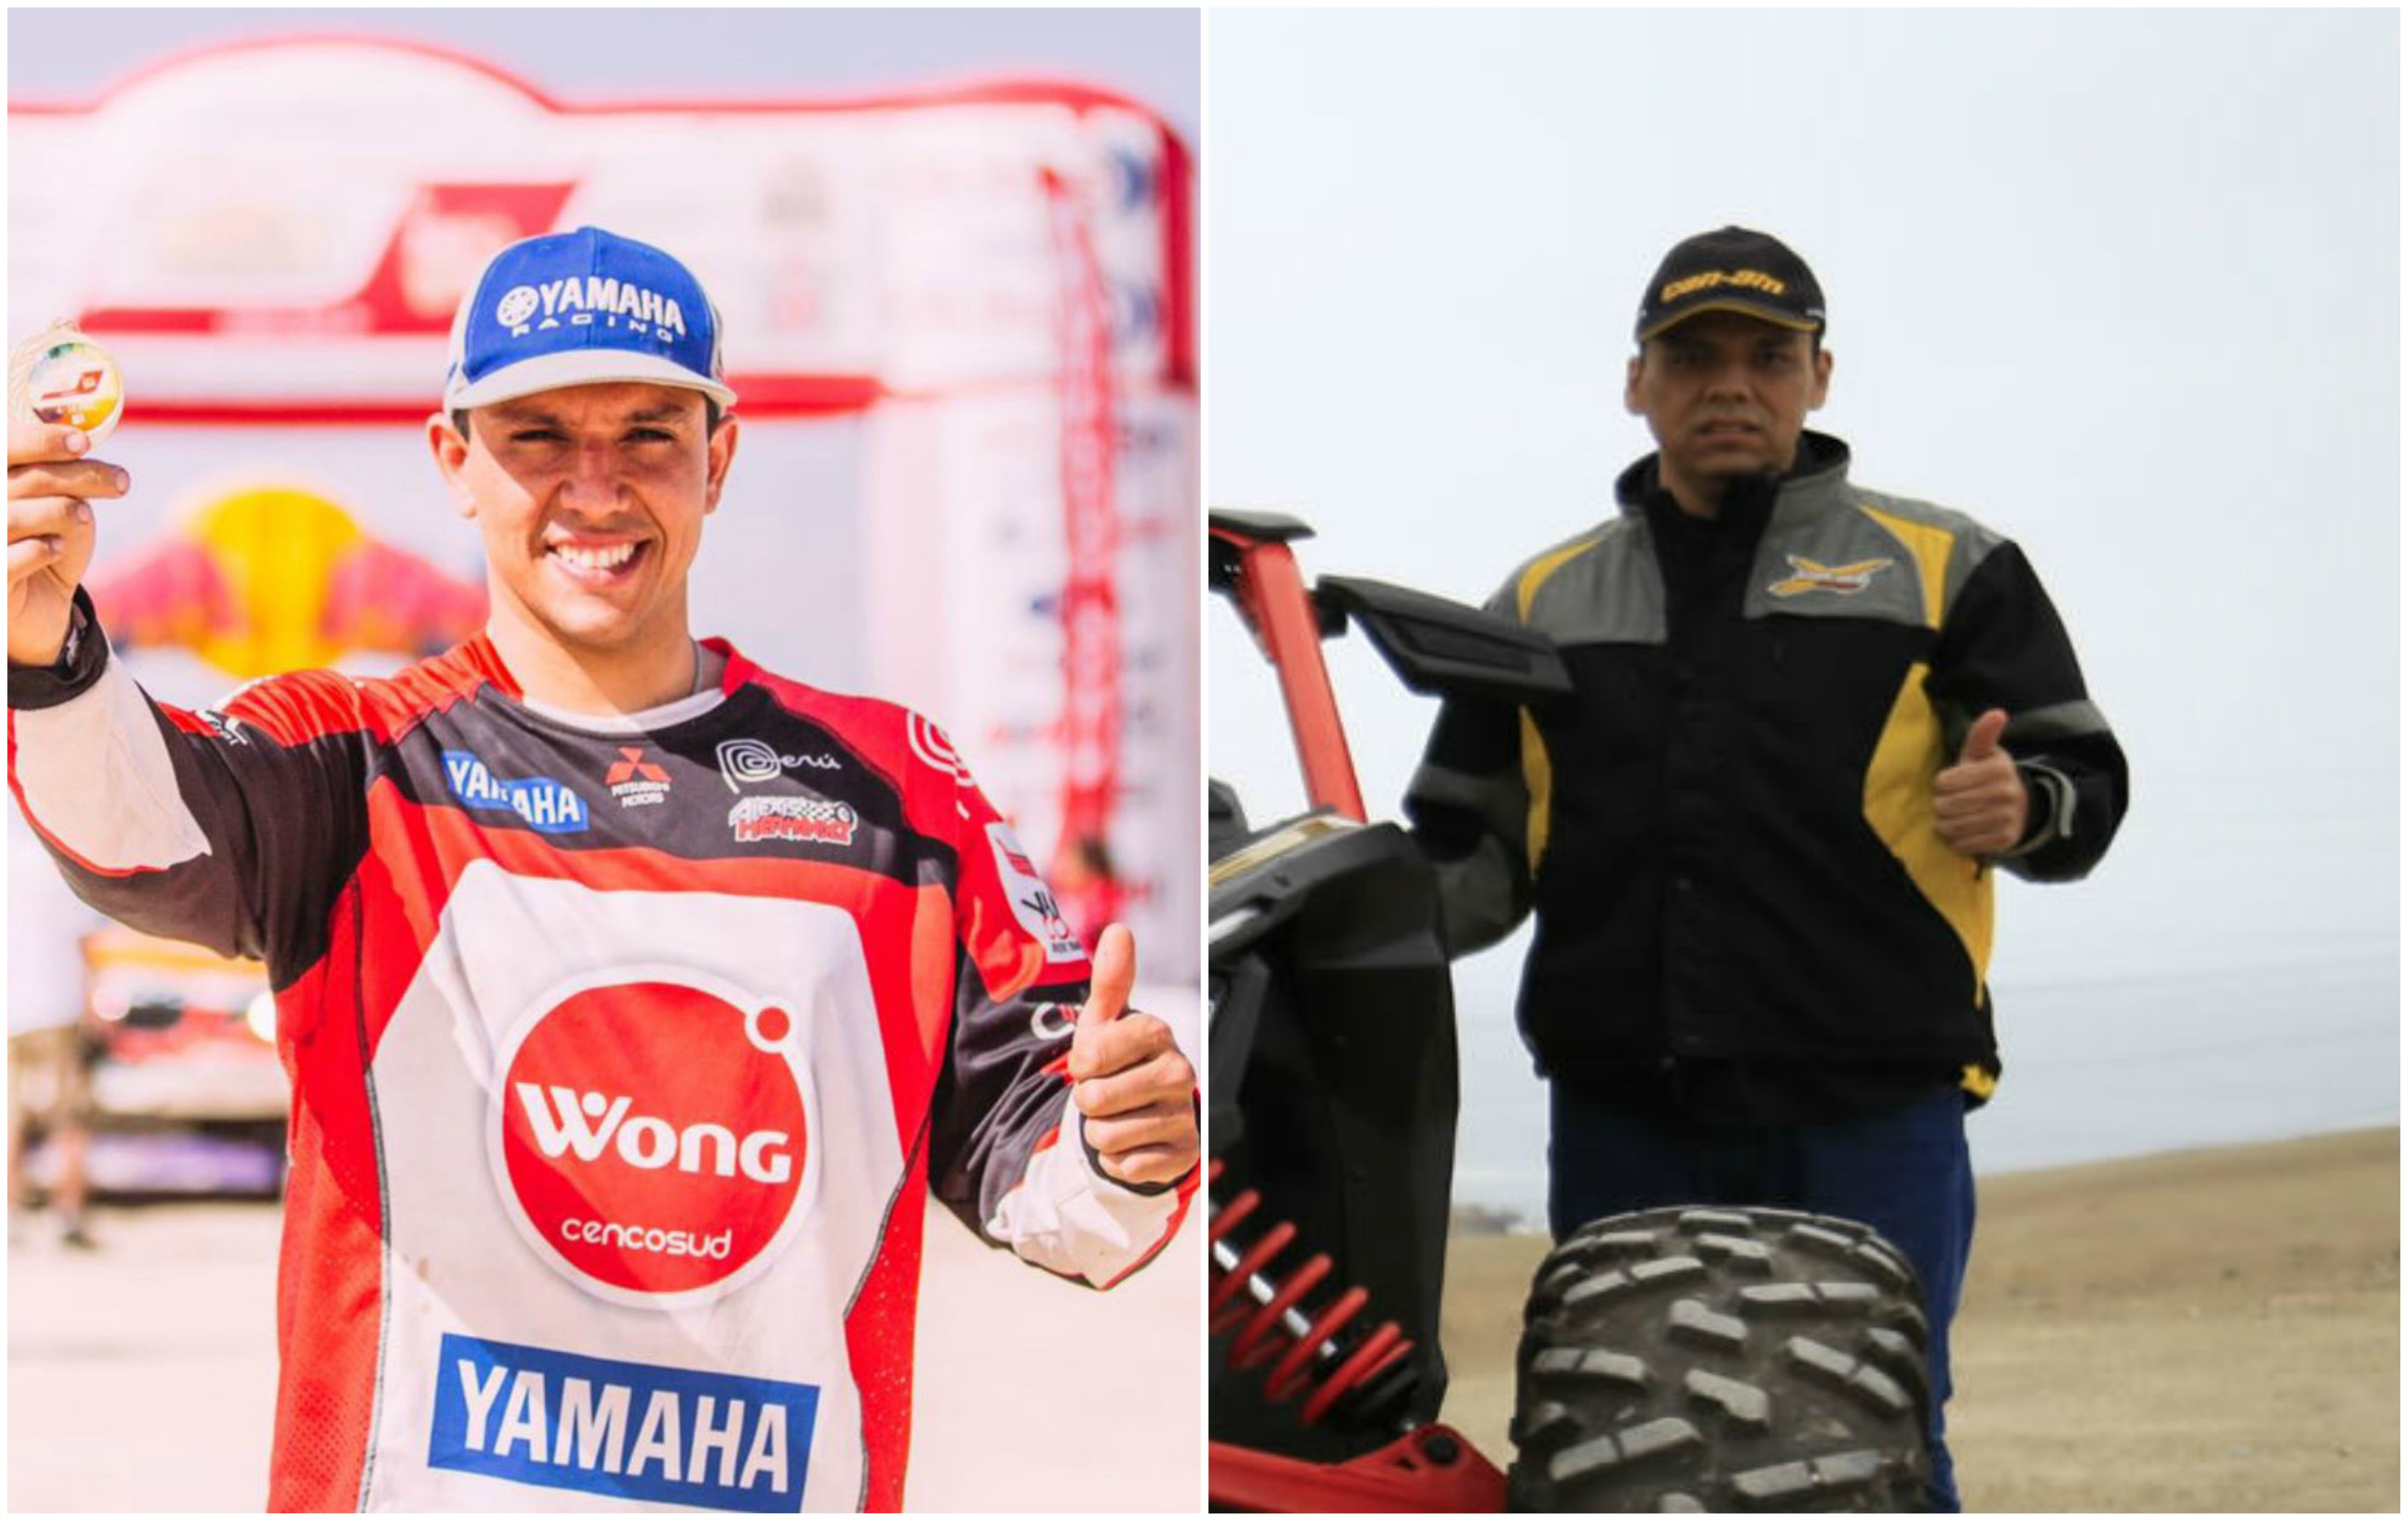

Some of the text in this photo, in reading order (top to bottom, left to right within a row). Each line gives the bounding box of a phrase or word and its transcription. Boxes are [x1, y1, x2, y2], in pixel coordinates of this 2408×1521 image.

[539, 276, 686, 336] YAMAHA
[512, 313, 673, 343] RACING
[611, 781, 670, 797] MITSUBISHI
[621, 791, 664, 808] MOTORS
[560, 1216, 732, 1260] cencosud
[458, 1358, 789, 1493] YAMAHA
